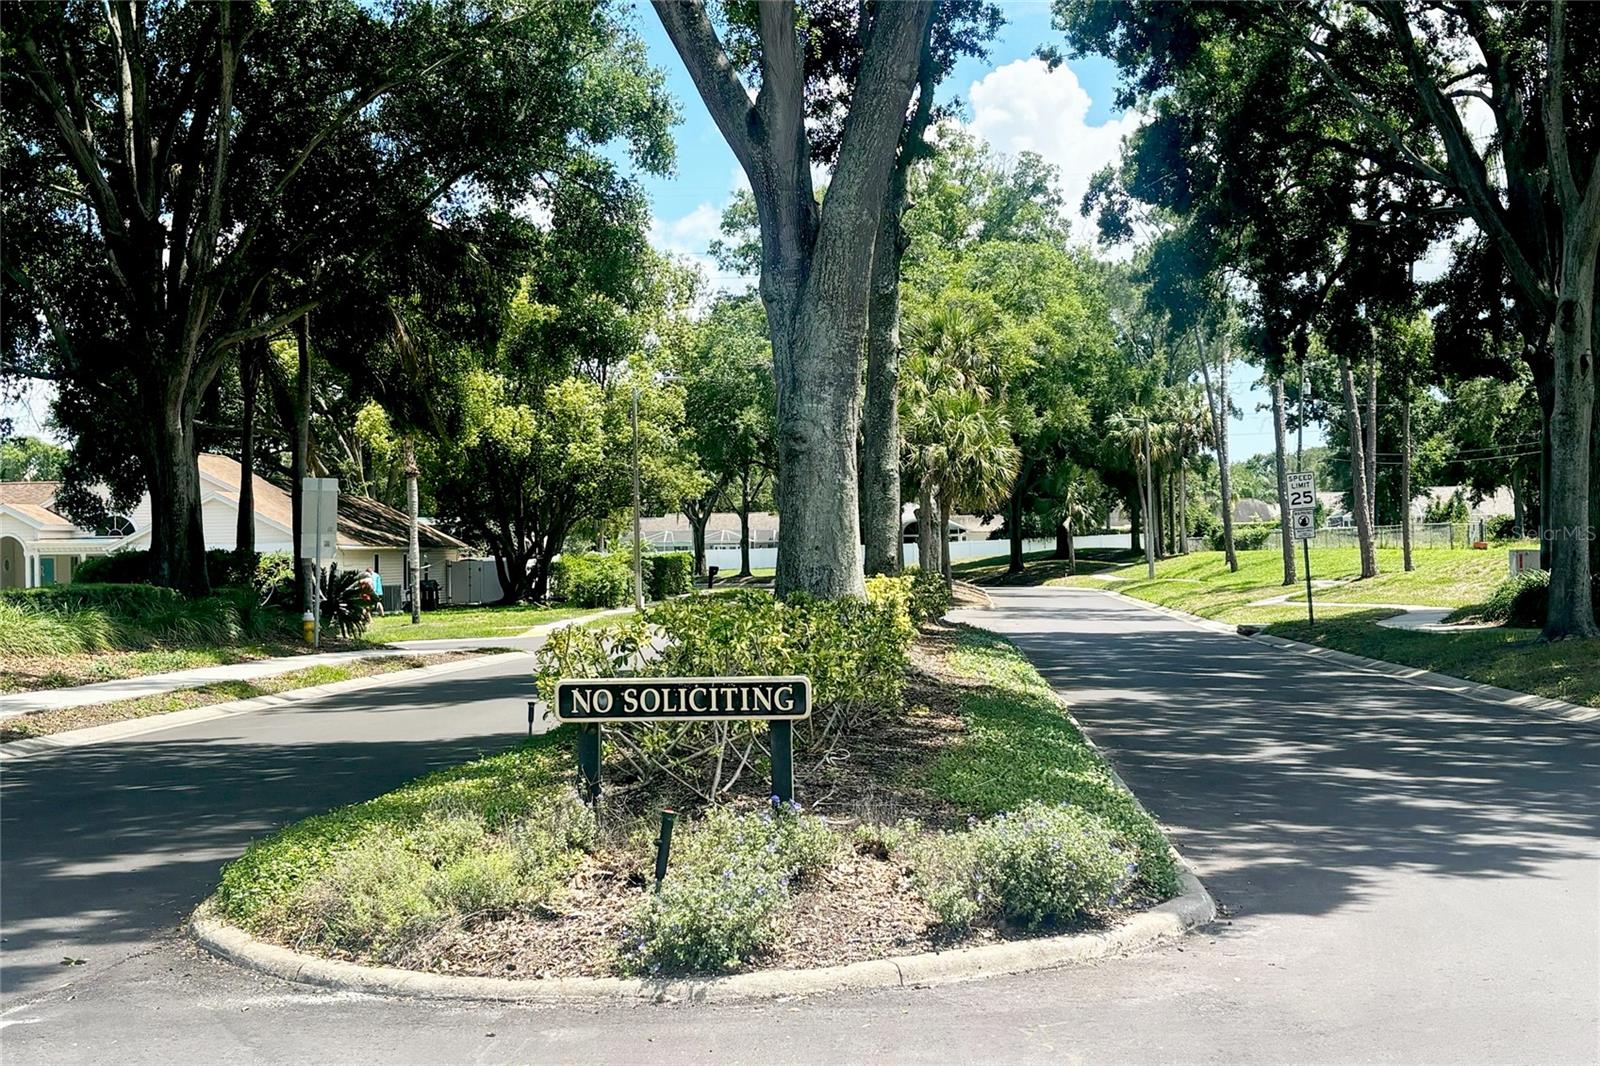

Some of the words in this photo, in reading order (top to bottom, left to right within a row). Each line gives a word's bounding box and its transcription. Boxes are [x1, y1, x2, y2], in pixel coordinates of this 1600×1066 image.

[1288, 474, 1312, 482] SPEED
[1291, 481, 1310, 489] LIMIT
[1290, 490, 1313, 505] 25
[571, 687, 613, 713] NO
[623, 686, 795, 713] SOLICITING
